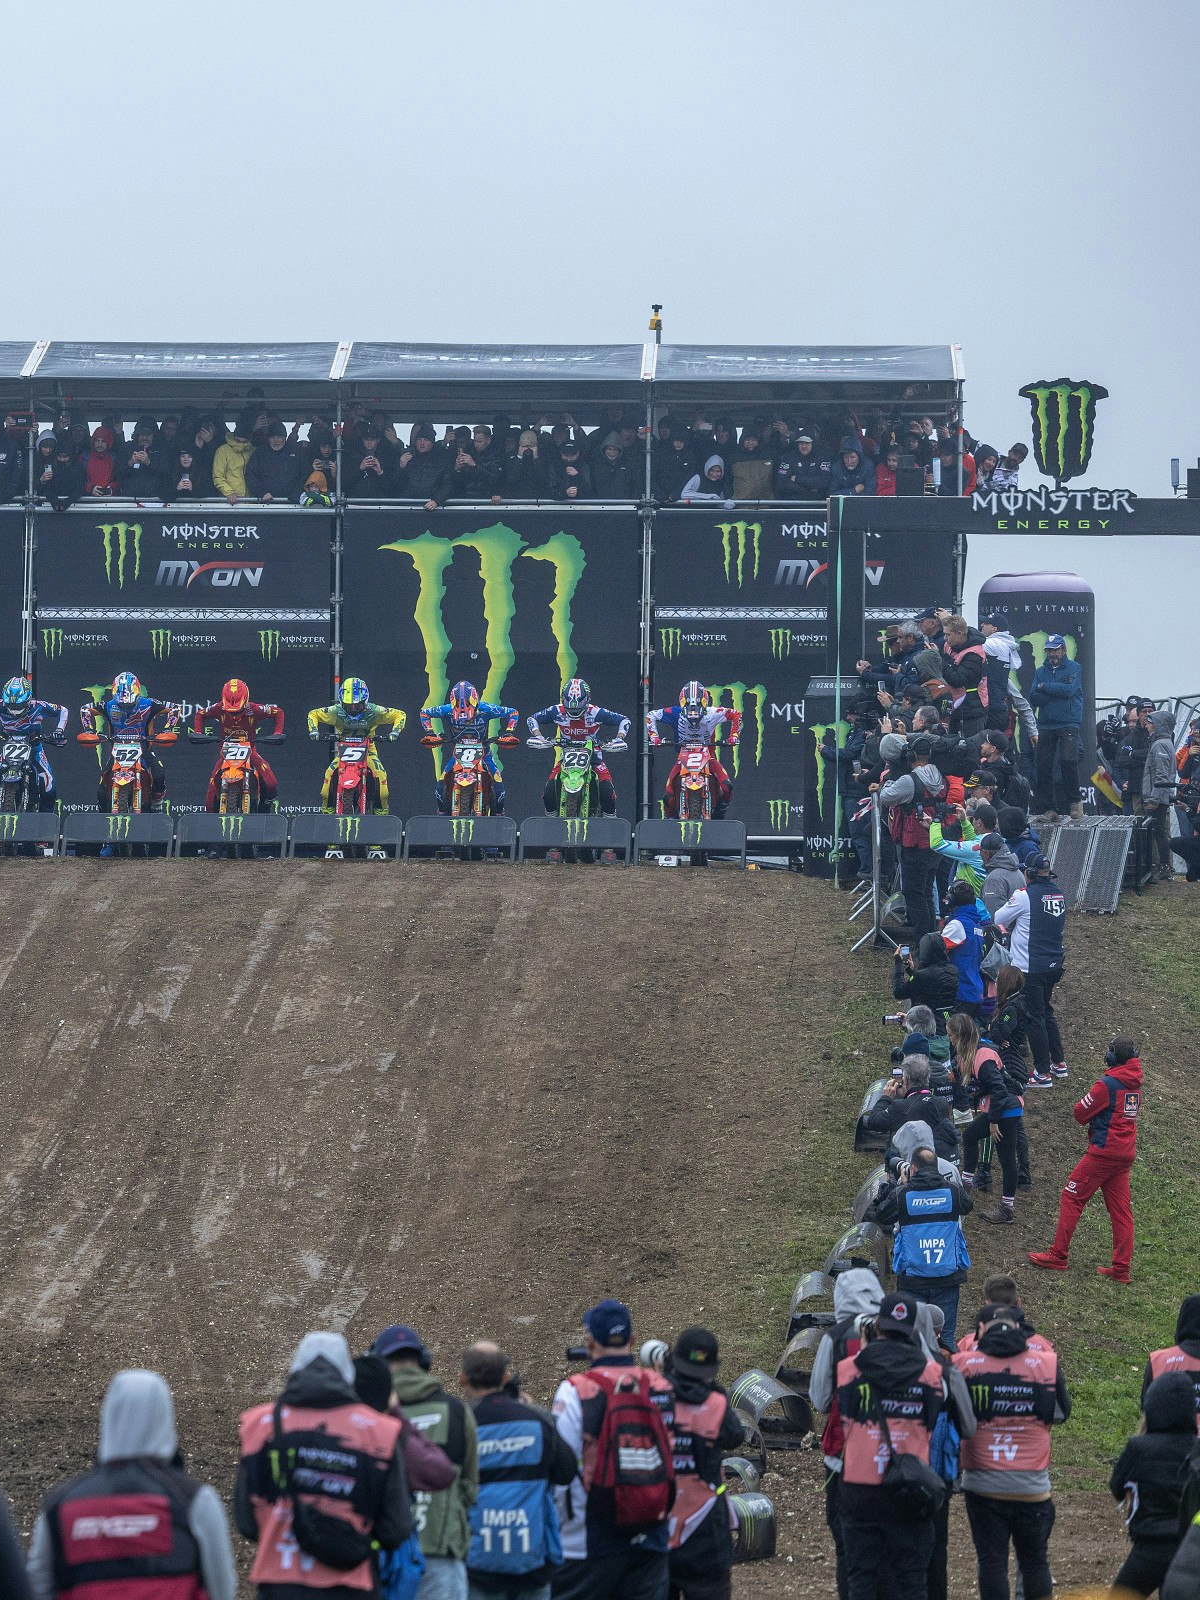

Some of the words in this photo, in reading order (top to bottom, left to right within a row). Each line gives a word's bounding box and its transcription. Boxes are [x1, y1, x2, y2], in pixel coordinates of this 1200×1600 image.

[971, 487, 1135, 516] MONSTER
[161, 522, 261, 540] MONSTER
[997, 520, 1111, 529] ENERGY
[1035, 604, 1090, 613] VITAMINS
[63, 633, 108, 642] MONSTER
[172, 633, 217, 643] MONSTER
[280, 634, 326, 644] MONSTER
[681, 632, 727, 642] MONSTER
[4, 744, 27, 760] 22
[116, 749, 139, 762] 52
[224, 747, 249, 760] 20
[340, 747, 366, 762] 5
[460, 749, 477, 763] 8
[564, 752, 591, 767] 28
[686, 753, 703, 767] 2
[62, 803, 99, 813] MONSTE
[171, 803, 207, 813] MONST
[806, 835, 853, 851] MONST
[911, 1197, 947, 1206] MXGP
[919, 1238, 946, 1249] IMPA
[922, 1249, 944, 1264] 17
[993, 1385, 1035, 1395] MONSTER
[988, 1444, 1019, 1461] TV
[482, 1507, 530, 1527] IMPA
[480, 1526, 531, 1554] 111
